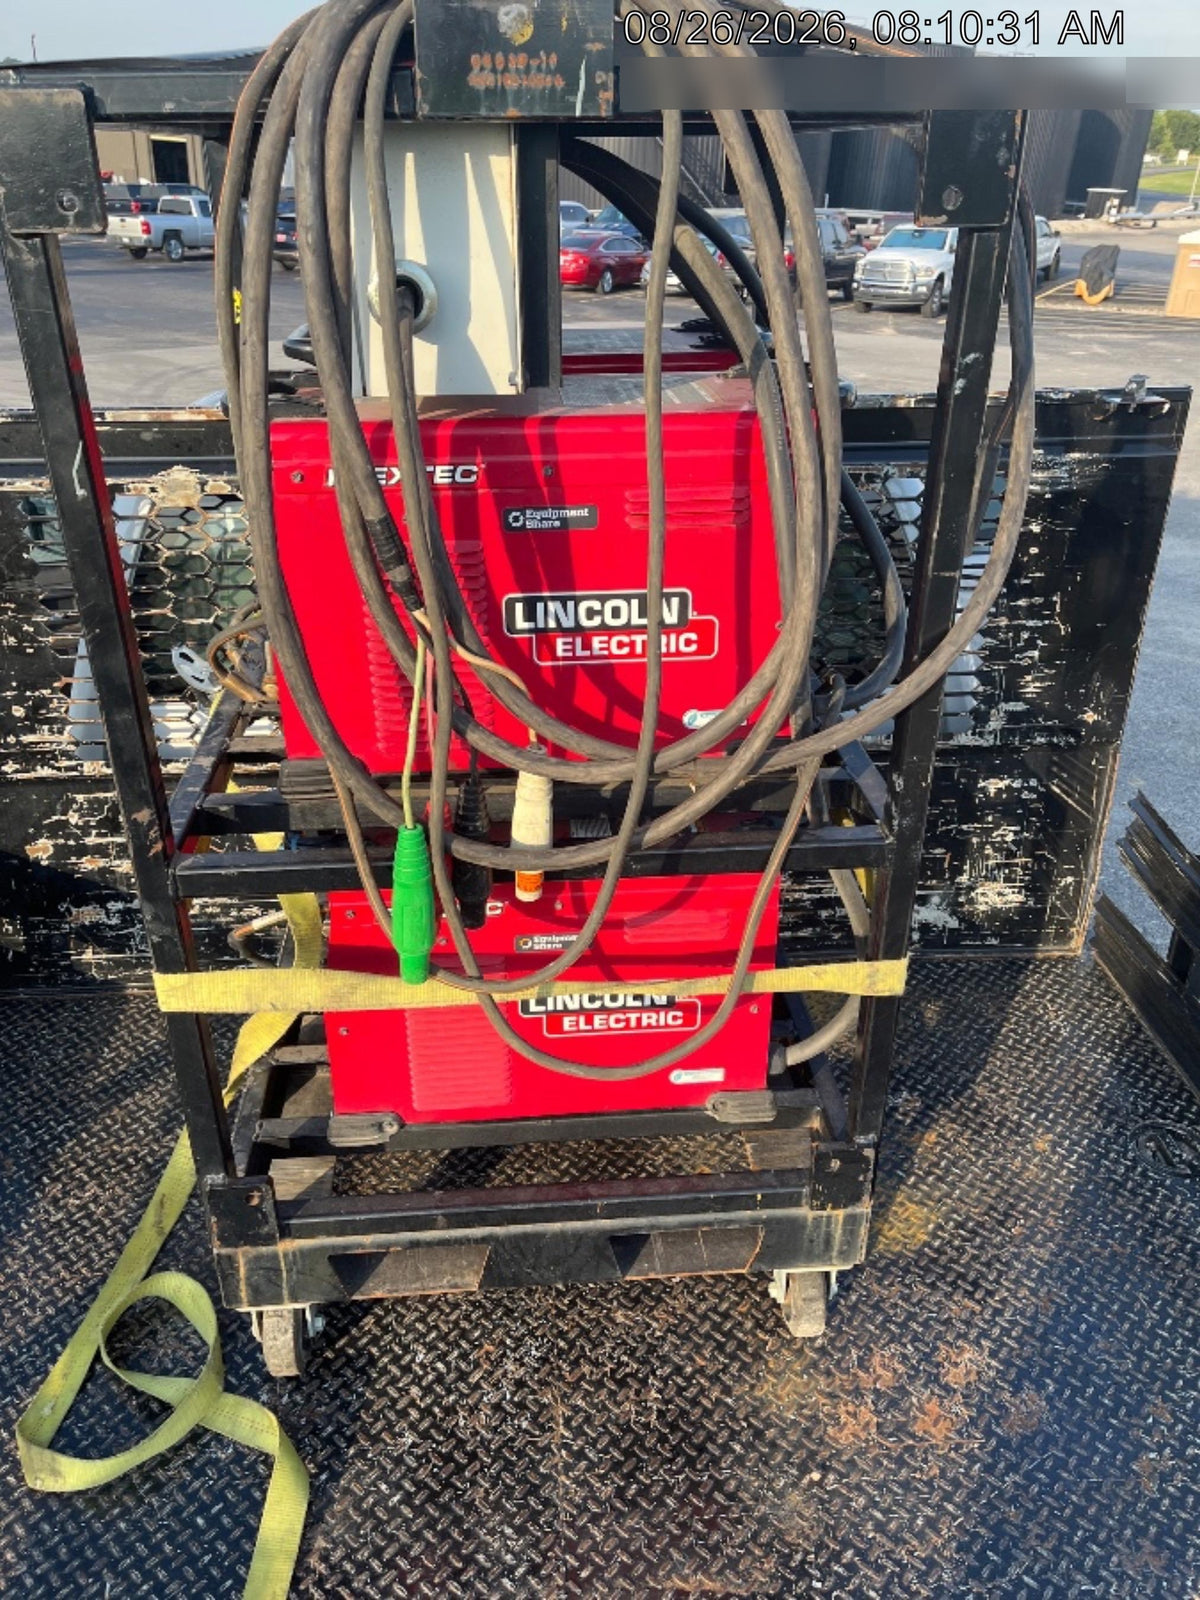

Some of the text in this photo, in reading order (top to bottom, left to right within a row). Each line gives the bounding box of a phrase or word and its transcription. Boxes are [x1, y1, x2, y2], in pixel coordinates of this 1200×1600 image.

[525, 508, 589, 519] Equipment
[525, 519, 561, 529] Share
[562, 1010, 684, 1032] ELECTRIC
